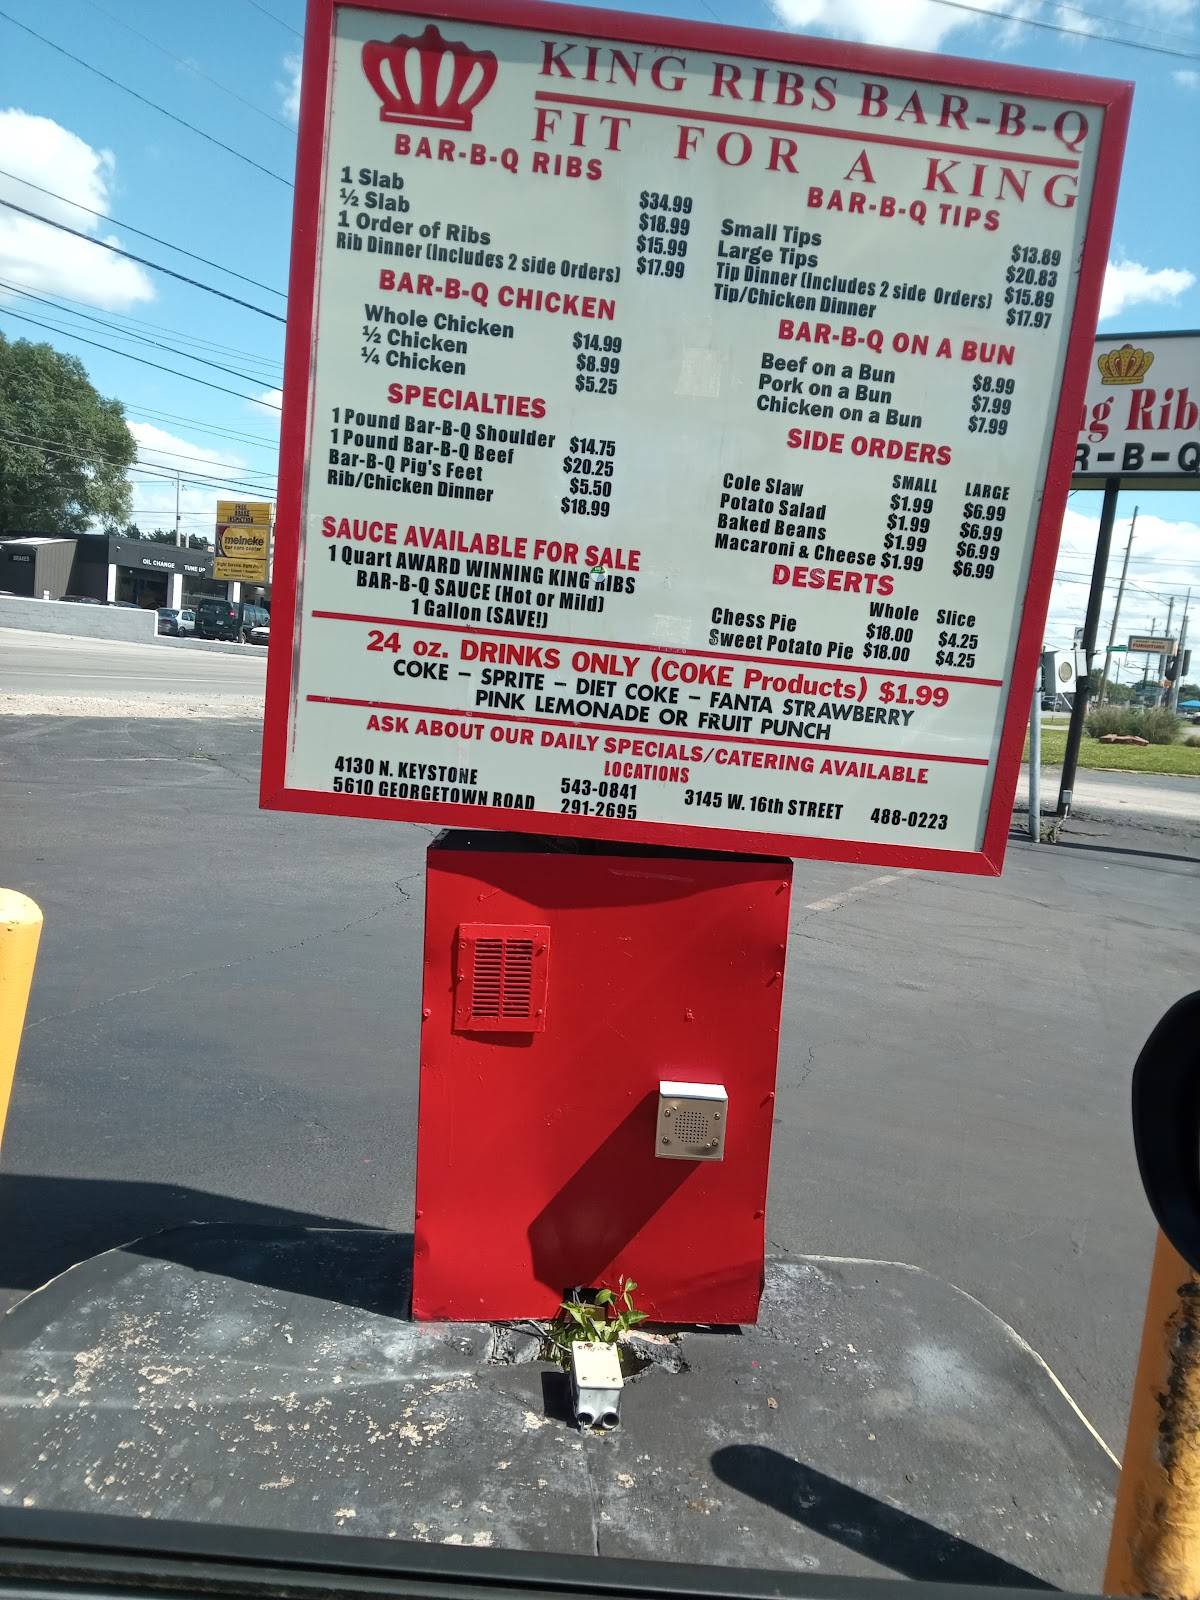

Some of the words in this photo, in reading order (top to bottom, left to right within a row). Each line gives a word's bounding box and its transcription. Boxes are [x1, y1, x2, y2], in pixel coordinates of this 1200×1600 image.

[538, 40, 687, 92] KING
[709, 61, 837, 112] RIBS
[857, 82, 1089, 153] BAR-B-Q
[394, 133, 519, 174] BAR-B-Q
[532, 151, 602, 181] RIBS
[531, 107, 631, 152] FIT
[673, 124, 799, 174] FOR
[922, 157, 1078, 208] KING
[358, 167, 404, 190] Slab
[364, 190, 410, 213] Slab
[638, 190, 693, 215] $34.99
[806, 186, 927, 226] BAR-B-Q
[938, 203, 1000, 231] TIPS
[355, 212, 414, 236] Order
[445, 223, 491, 246] Ribs
[638, 211, 690, 236] $18.99
[720, 218, 778, 241] Small
[782, 225, 822, 248] Tips
[366, 235, 422, 259] Dinner
[636, 233, 688, 258] $15.99
[717, 239, 774, 265] Large
[779, 246, 818, 270] Tips
[1010, 243, 1062, 267] $13.89
[636, 255, 685, 279] $17.99
[743, 264, 798, 287] Dinner
[1005, 264, 1058, 288] $20.83
[378, 268, 489, 307] BAR-B-Q
[497, 285, 616, 321] CHICKEN
[713, 282, 816, 312] Tip/Chicken
[819, 295, 877, 318] Dinner
[1004, 285, 1055, 309] $15.89
[364, 303, 428, 328] Whole
[433, 312, 514, 339] Chicken
[1005, 307, 1052, 329] $17.97
[386, 328, 468, 354] Chicken
[572, 330, 622, 354] $14.99
[777, 318, 884, 354] BAR-B-Q
[960, 340, 1016, 366] BUN
[385, 349, 466, 376] Chicken
[575, 352, 620, 375] $8.99
[760, 352, 808, 373] Beef
[574, 373, 618, 395] $5.25
[758, 372, 804, 394] Pork
[972, 373, 1015, 395] $8.99
[386, 382, 546, 419] SPECIALTIES
[756, 394, 834, 418] Chicken
[971, 394, 1012, 416] $7.99
[1125, 387, 1200, 430] Rib
[344, 408, 400, 431] Pound
[404, 415, 471, 441] Bar-B-Q
[475, 423, 556, 448] Shoulder
[967, 414, 1008, 436] $7.99
[342, 428, 399, 451] Pound
[402, 436, 470, 461] Bar-B-Q
[473, 444, 514, 464] Beef
[569, 435, 616, 457] $14.75
[786, 427, 845, 454] SIDE
[850, 435, 952, 466] ORDERS
[328, 448, 395, 474] Bar-B-Q
[399, 456, 442, 477] Pig's
[562, 455, 614, 477] $20.25
[327, 468, 433, 496] Rib/Chicken
[436, 480, 494, 502] Dinner
[569, 476, 612, 498] $5.50
[722, 472, 761, 492] Cole
[764, 477, 804, 497] Slaw
[892, 474, 937, 494] SMALL
[964, 481, 1010, 501] LARGE
[560, 495, 610, 518] $18.99
[719, 492, 774, 514] Potato
[778, 499, 827, 521] Salad
[889, 493, 934, 514] $1.99
[962, 501, 1006, 522] $6.99
[716, 512, 771, 534] Baked
[774, 519, 827, 541] Beans
[886, 512, 931, 534] $1.99
[959, 521, 1003, 542] $6.99
[224, 535, 265, 546] meineke
[321, 515, 398, 545] SAUCE
[403, 525, 528, 560] AVAILABLE
[532, 538, 579, 565] FOR
[584, 544, 641, 572] SALE
[714, 532, 795, 557] Macaroni
[813, 544, 876, 567] Cheese
[883, 531, 927, 553] $1.99
[955, 540, 1000, 561] $6.99
[142, 558, 152, 566] OIL
[152, 560, 175, 569] CHANGE
[183, 564, 198, 572] TUNE
[341, 545, 392, 568] Quart
[395, 551, 461, 575] AWARD
[465, 558, 544, 585] WINNING
[548, 568, 591, 590] KING
[880, 551, 924, 572] $1.99
[952, 559, 995, 580] $6.99
[356, 570, 430, 596] BAR-B-Q
[434, 578, 491, 601] SAUCE
[771, 563, 894, 596] DESERTS
[423, 598, 482, 622] Gallon
[711, 606, 766, 629] Chess
[869, 601, 919, 622] Whole
[935, 608, 976, 628] Slice
[708, 628, 763, 651] Sweet
[766, 634, 823, 657] Potato
[865, 622, 914, 644] $18.00
[937, 630, 978, 650] $4.25
[862, 641, 911, 662] $18.00
[934, 649, 976, 669] $4.25
[459, 639, 561, 670] DRINKS
[571, 650, 640, 678] ONLY
[650, 655, 735, 688] (COKE
[743, 668, 868, 703] Products)
[878, 680, 949, 708] $1.99
[392, 658, 449, 681] COKE
[480, 667, 545, 691] SPRITE
[575, 677, 618, 698] DIET
[624, 682, 680, 704] COKE
[709, 691, 773, 714] FANTA
[782, 698, 915, 726] STRAWBERRY
[474, 689, 525, 711] PINK
[534, 695, 650, 723] LEMONADE
[697, 711, 753, 733] FRUIT
[760, 717, 832, 741] PUNCH
[414, 718, 485, 741] ABOUT
[540, 730, 600, 752] DAILY
[603, 736, 815, 773] SPECIALS/CATERING
[818, 758, 929, 784] AVAILABLE
[334, 755, 374, 775] 4130
[397, 761, 478, 785] KEYSTONE
[603, 760, 690, 784] LOCATIONS
[332, 776, 374, 795] 5610
[378, 780, 488, 806] GEORGETOWN
[492, 791, 535, 810] ROAD
[560, 777, 637, 800] 543-0841
[560, 797, 637, 820] 291-2695
[684, 788, 723, 808] 3145
[749, 795, 784, 814] 16th
[787, 799, 844, 820] STREET
[869, 807, 948, 830] 488-0223
